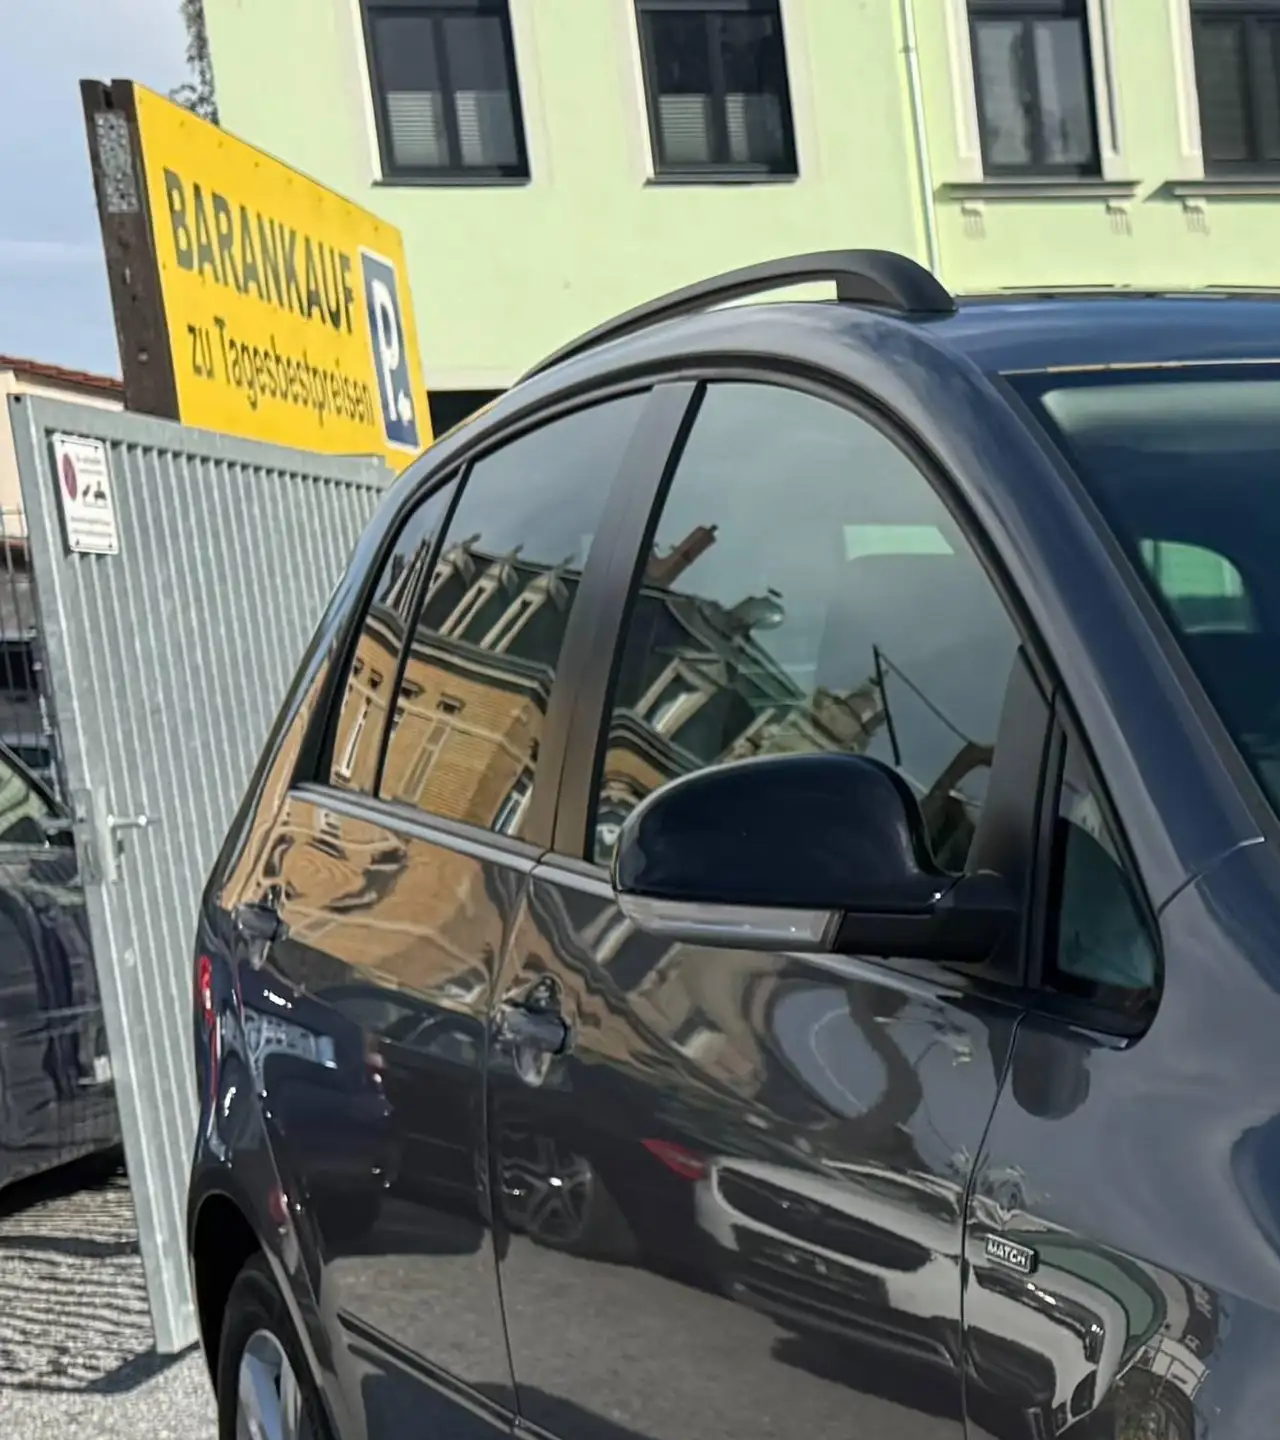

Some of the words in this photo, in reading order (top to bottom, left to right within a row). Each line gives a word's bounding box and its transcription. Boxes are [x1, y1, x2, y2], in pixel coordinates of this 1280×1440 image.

[163, 166, 354, 336] BARANKAUF
[187, 323, 215, 379] zu
[213, 316, 376, 428] Tagesbestpreisen
[987, 1240, 1026, 1266] MATCH
